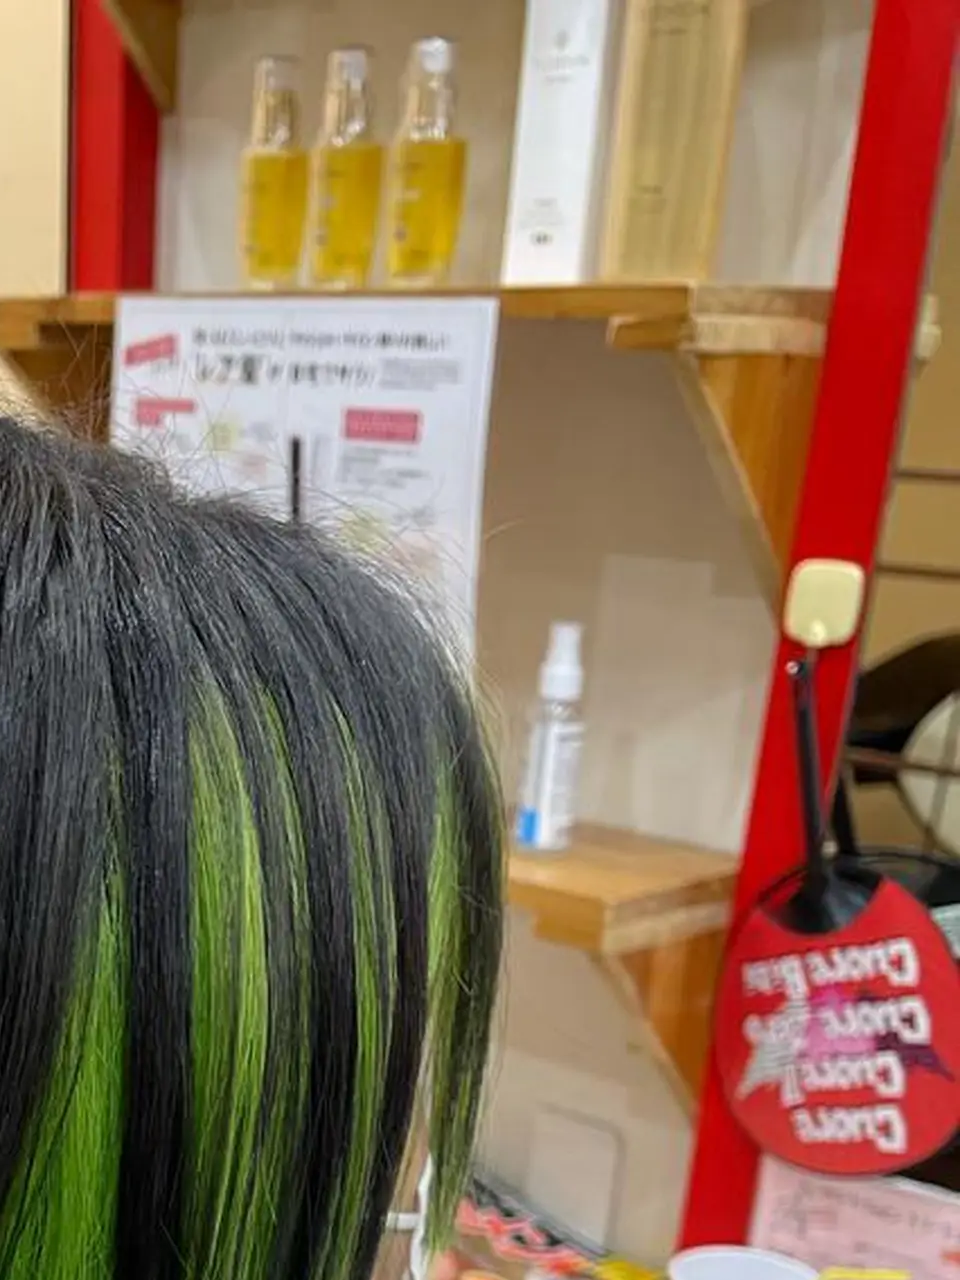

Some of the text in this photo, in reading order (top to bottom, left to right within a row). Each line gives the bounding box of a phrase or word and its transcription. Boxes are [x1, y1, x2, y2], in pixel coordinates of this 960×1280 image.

[806, 937, 920, 987] Cuore
[819, 995, 931, 1046] Cuore
[803, 1050, 906, 1099] Cuore
[792, 1105, 907, 1154] Cuore
